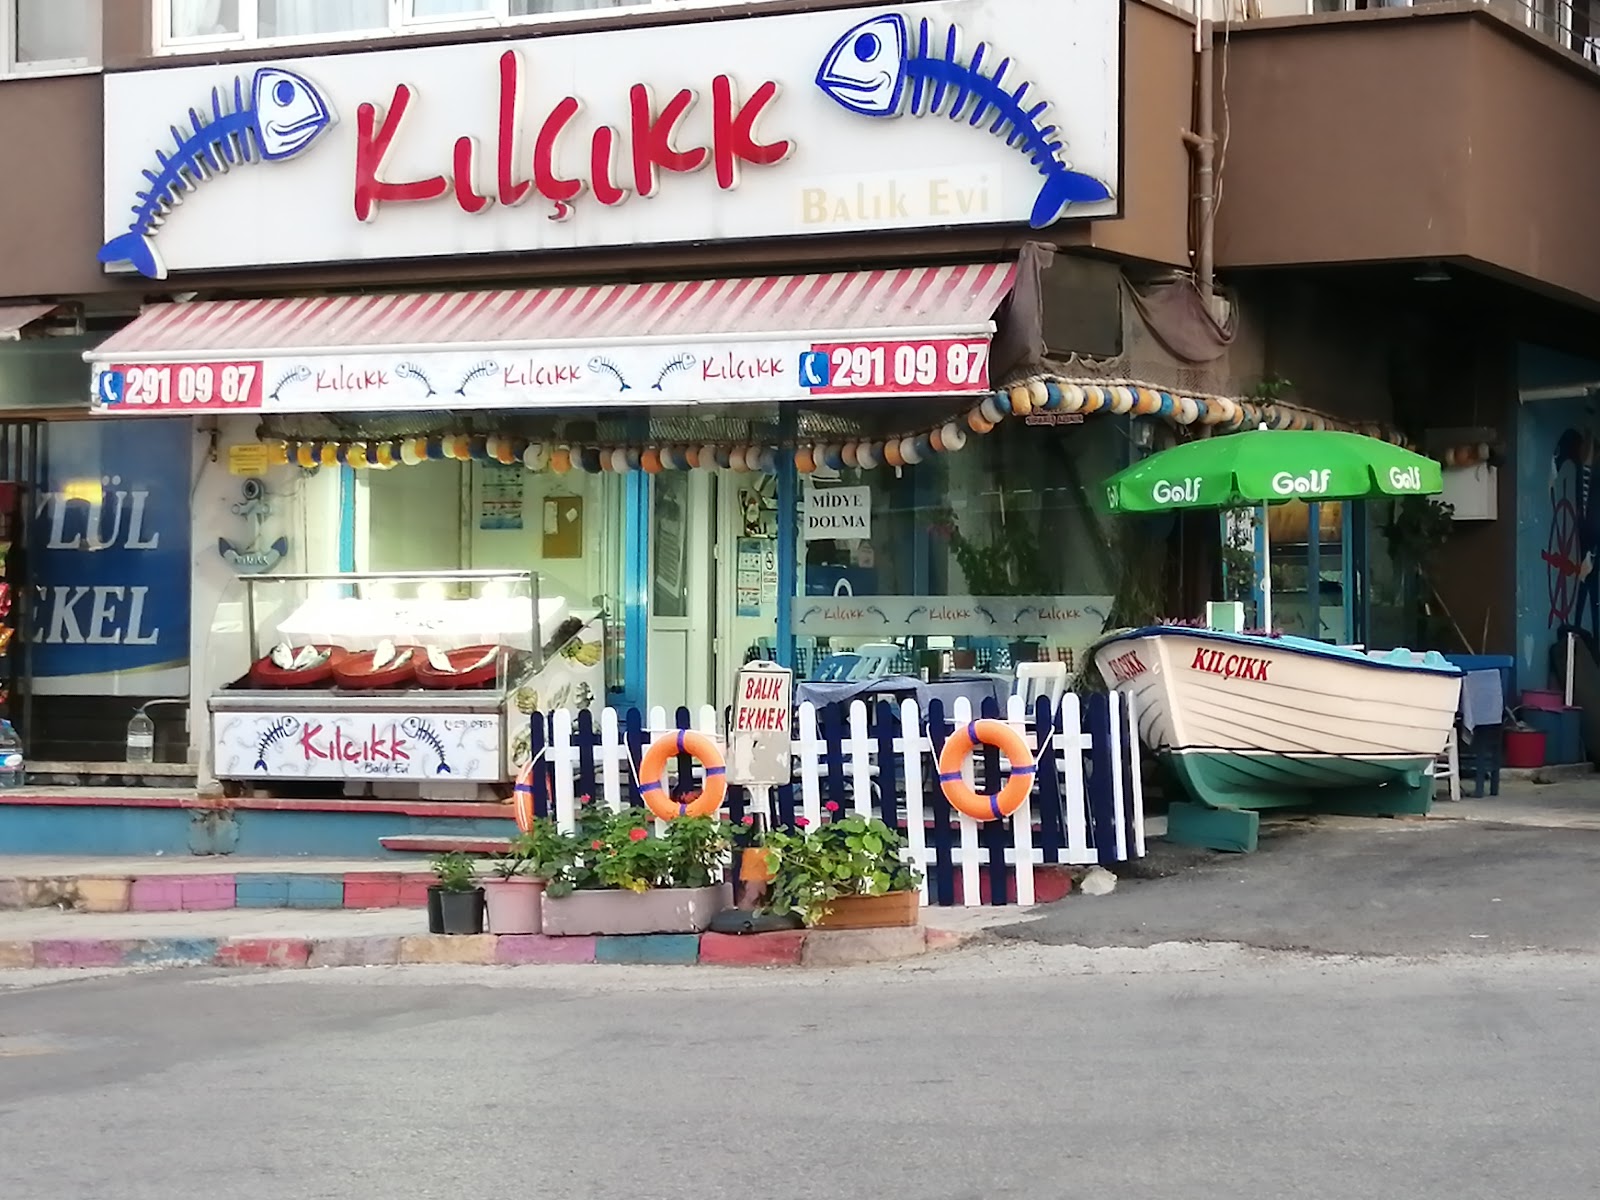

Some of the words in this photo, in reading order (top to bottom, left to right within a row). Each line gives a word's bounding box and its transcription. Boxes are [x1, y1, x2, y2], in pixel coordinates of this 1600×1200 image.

[928, 175, 989, 216] Evi
[831, 346, 885, 387] 291
[894, 345, 937, 386] 09
[946, 343, 988, 384] 87
[125, 367, 171, 404] 291
[178, 366, 213, 402] 09
[221, 365, 255, 401] 87
[1152, 477, 1203, 504] Golf
[1271, 468, 1332, 495] Golf
[1389, 466, 1420, 490] Golf
[812, 492, 863, 508] MİDYE
[809, 515, 866, 529] DOLMA
[1191, 647, 1273, 681] KILÇIKK
[745, 677, 784, 702] BALIK
[738, 706, 786, 732] EKMEK
